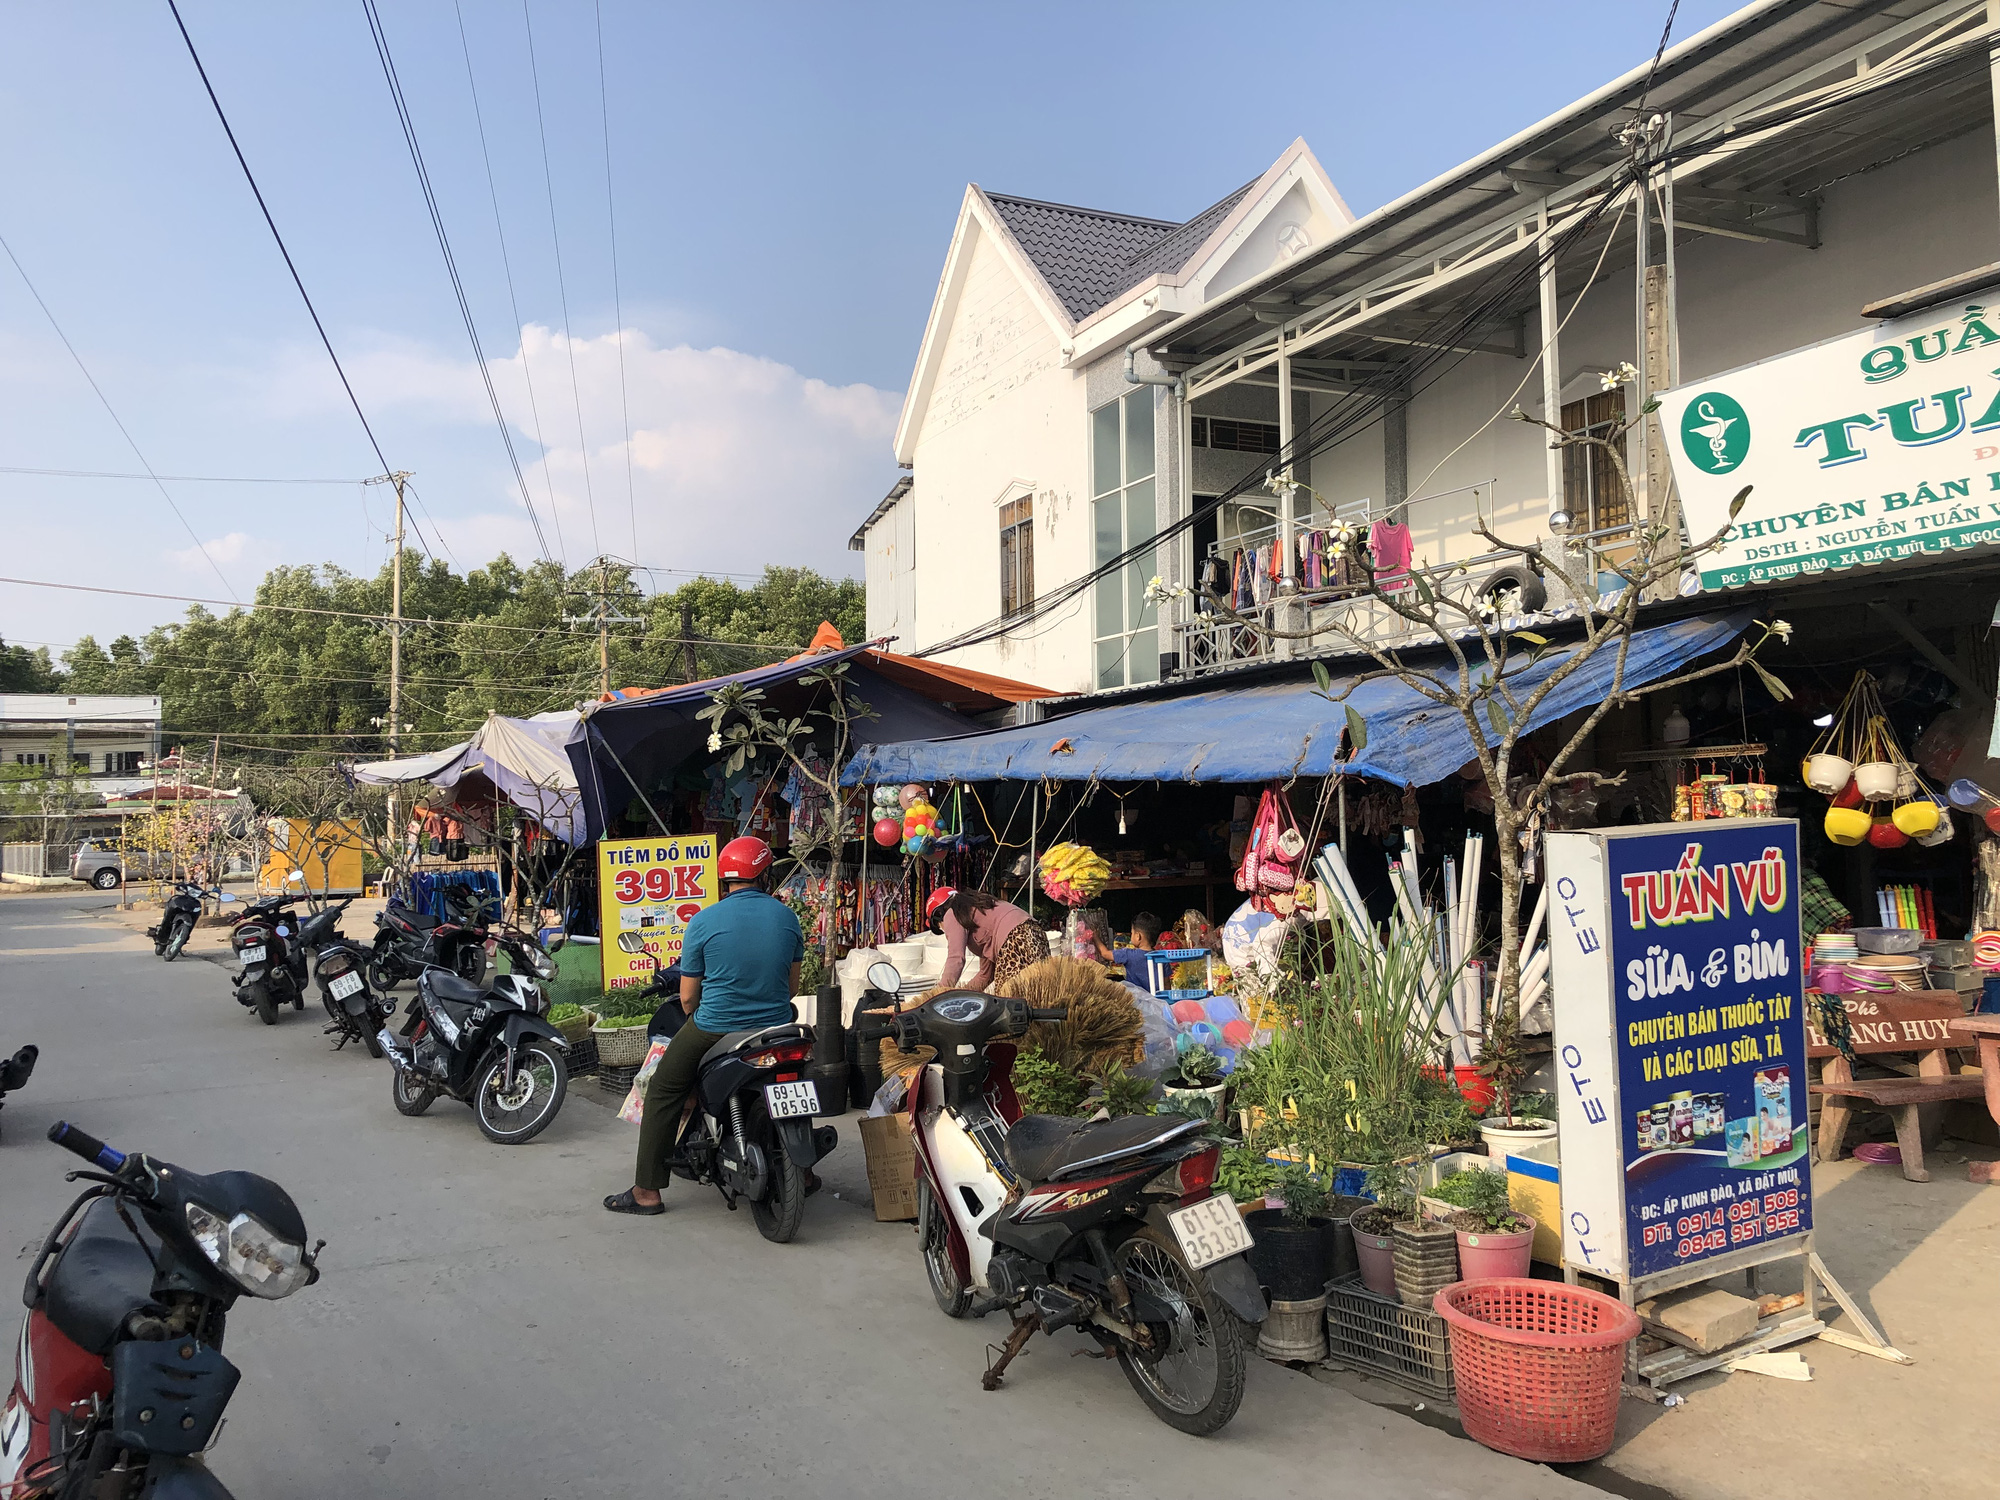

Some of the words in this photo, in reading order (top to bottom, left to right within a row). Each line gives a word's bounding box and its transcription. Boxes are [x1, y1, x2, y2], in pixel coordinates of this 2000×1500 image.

[1860, 304, 2000, 384] QUẦ
[1881, 478, 1970, 512] BÁN
[1744, 540, 1798, 561] DSTH
[1816, 517, 1907, 548] NGUYỄN
[1915, 503, 1980, 529] TUẤN
[1748, 566, 1764, 580] ẤP
[1767, 562, 1799, 577] KINH
[1801, 557, 1829, 571] ĐÀO
[1840, 550, 1861, 565] XÃ
[1863, 543, 1893, 560] ĐẤT
[1896, 540, 1926, 555] MŨI
[607, 846, 650, 866] TIỆM
[656, 841, 680, 861] ĐỒ
[685, 839, 710, 859] MỦ
[614, 864, 706, 905] 39K
[1621, 843, 1730, 930] TUẤN
[1731, 847, 1786, 916] VŨ
[1557, 876, 1600, 954] ETO
[1626, 944, 1694, 1001] SỮA
[1701, 948, 1728, 987] &
[1733, 928, 1790, 983] BỈM
[1628, 1011, 1685, 1047] CHUYÊN
[1688, 1005, 1717, 1036] BÁN
[1720, 993, 1764, 1030] THUỐC
[1767, 991, 1792, 1022] TÂY
[1843, 1000, 1879, 1016] Phê
[1900, 1019, 1951, 1041] HUY
[1642, 1051, 1663, 1082] VÀ
[1665, 1047, 1694, 1078] CÁC
[1697, 1043, 1728, 1073] LOẠI
[1731, 1035, 1763, 1063] SỮA,
[1765, 1026, 1784, 1058] TẢ
[773, 1083, 809, 1100] 69-L1
[773, 1098, 817, 1116] 185.96
[1562, 1044, 1607, 1124] ETO
[1641, 1204, 1661, 1220] ĐC:
[1663, 1194, 1679, 1215] ẤP
[1681, 1191, 1709, 1210] KINH
[1710, 1183, 1736, 1202] ĐÀO,
[1738, 1177, 1753, 1196] XÃ
[1754, 1170, 1775, 1191] ĐẤT
[1777, 1166, 1798, 1185] MŨI
[1643, 1221, 1672, 1247] ĐT:
[1677, 1207, 1724, 1236] 0914
[1729, 1198, 1760, 1222] 091
[1763, 1188, 1799, 1213] 508
[1186, 1222, 1248, 1264] 353.97
[1570, 1211, 1611, 1275] TO
[1678, 1229, 1727, 1258] 0842
[1731, 1218, 1762, 1243] 951
[1766, 1208, 1799, 1232] 952
